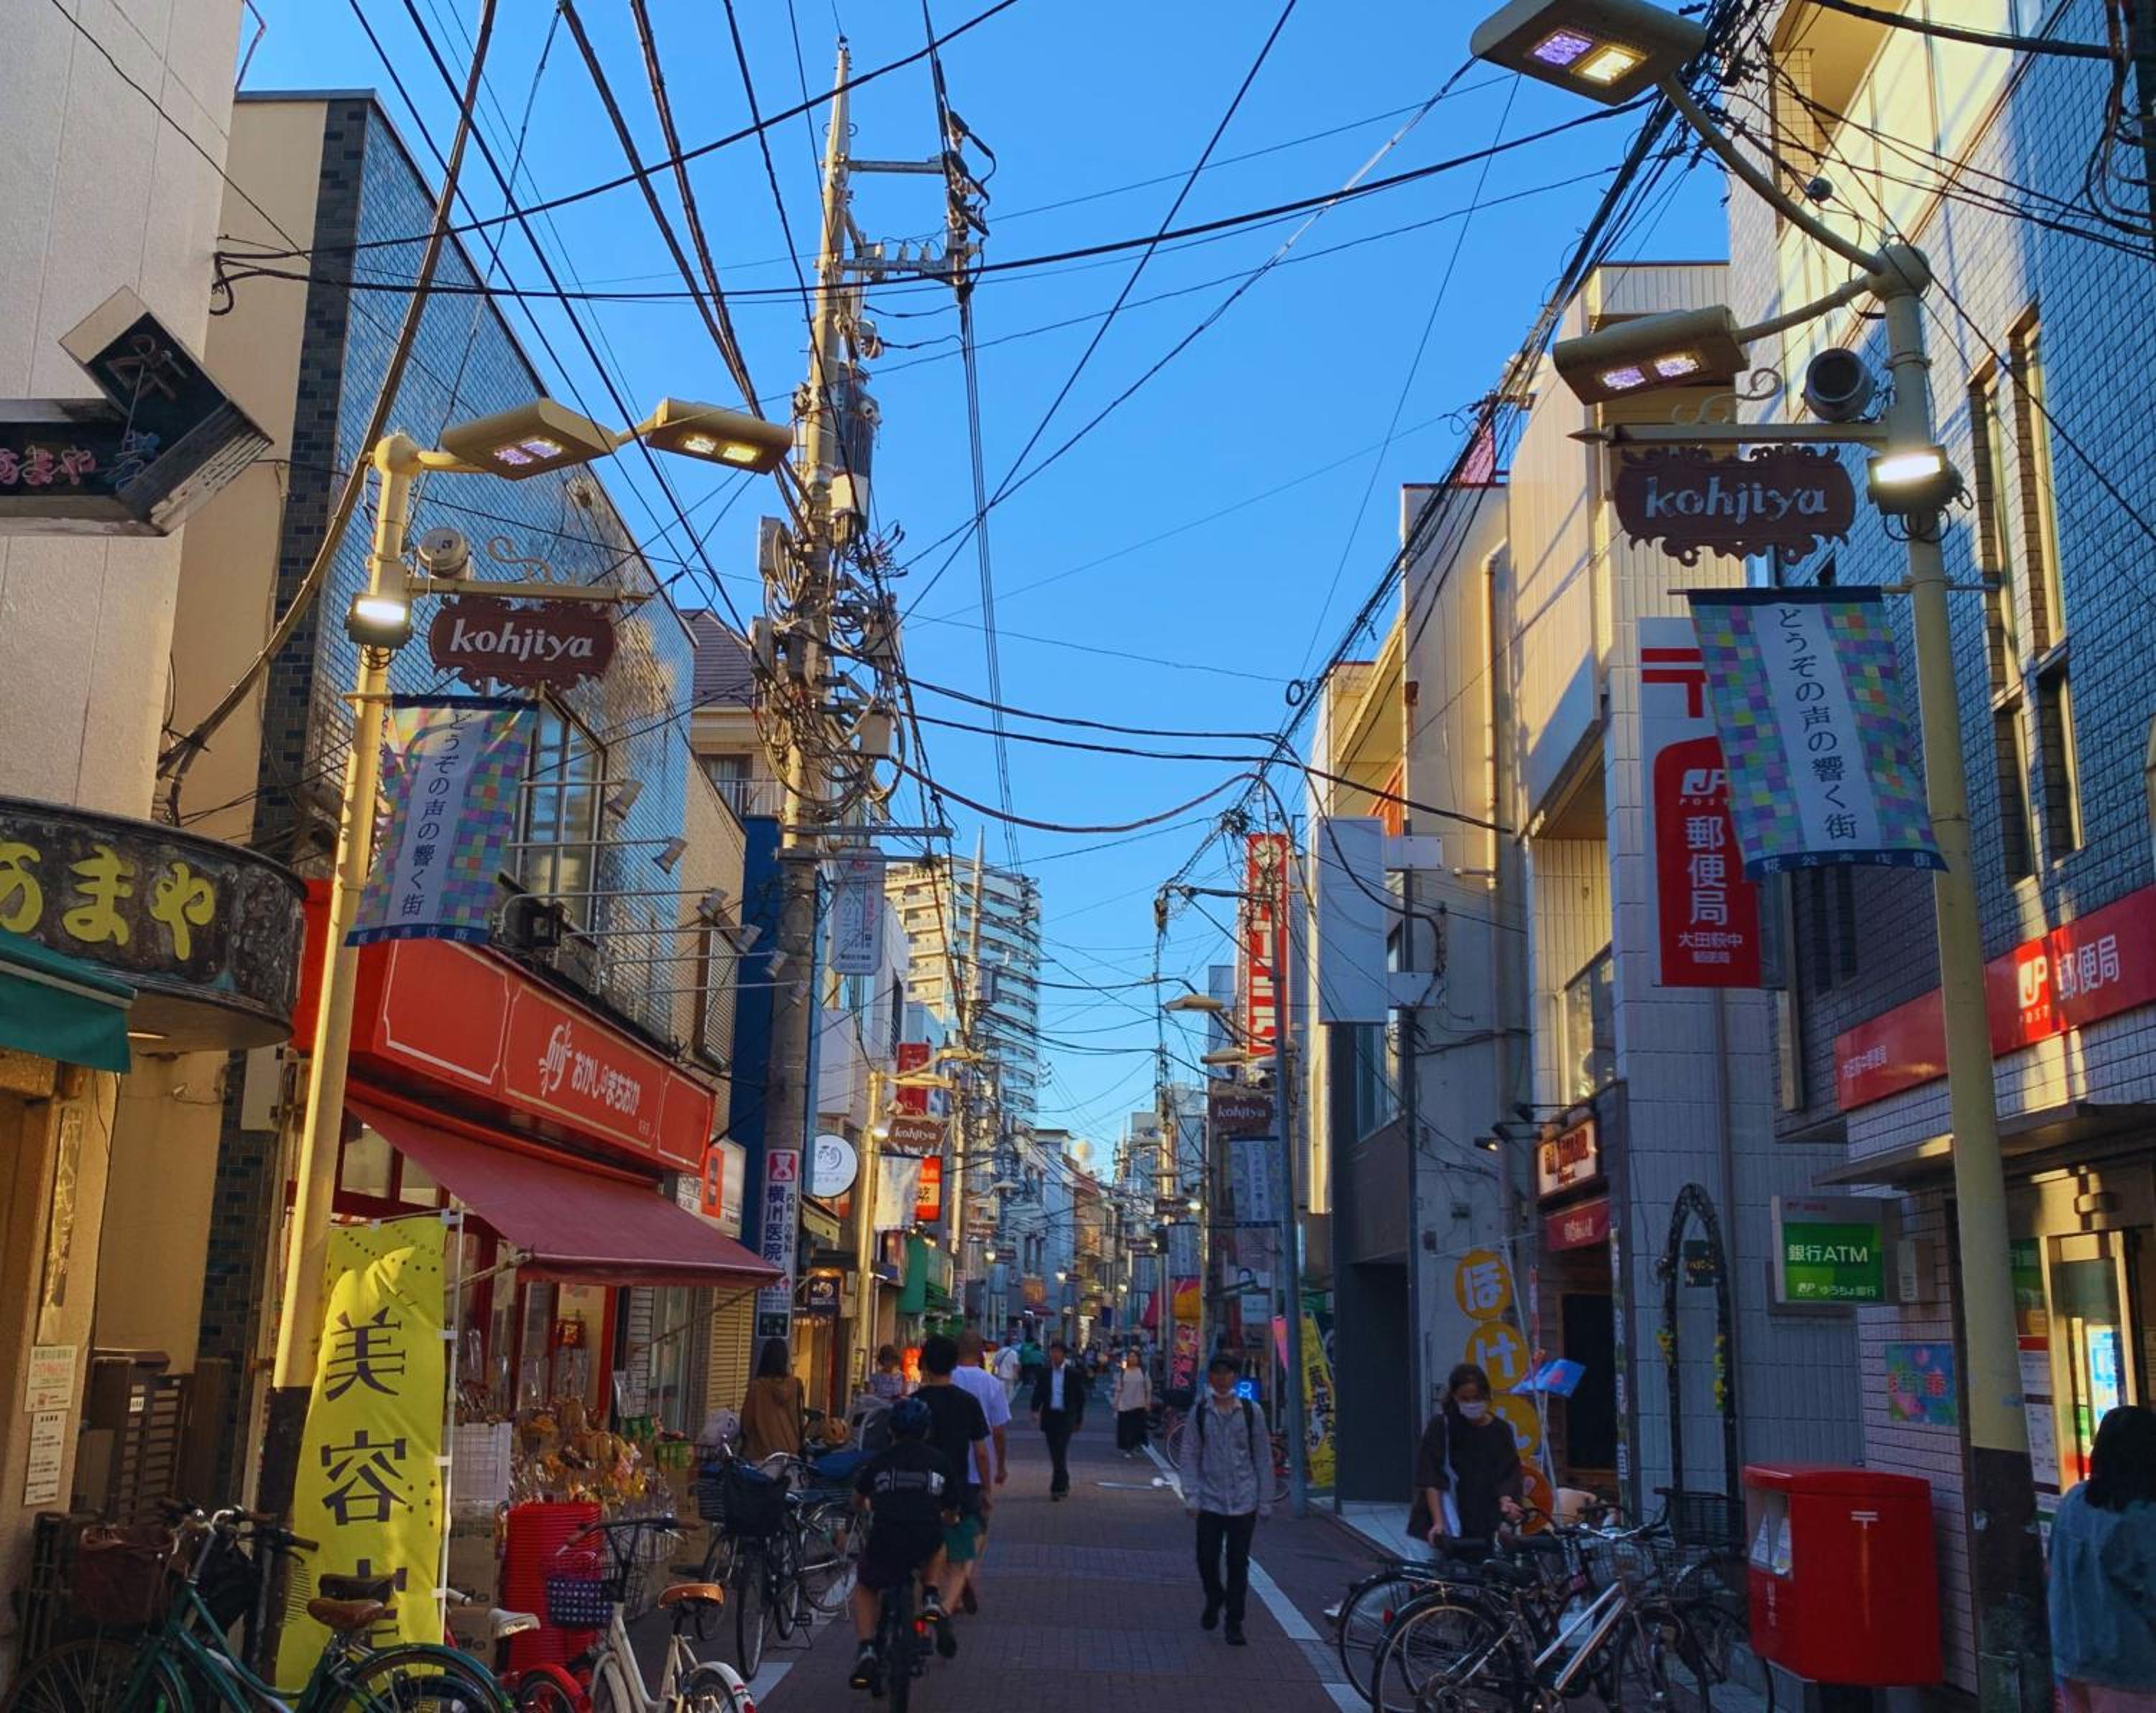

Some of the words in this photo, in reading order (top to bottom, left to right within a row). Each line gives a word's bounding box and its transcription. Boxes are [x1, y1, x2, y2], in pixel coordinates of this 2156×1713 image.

[1645, 476, 1829, 525] kohjiya
[450, 619, 594, 661] kohjiya
[1778, 608, 1858, 841] どうぞの声の響く街
[402, 713, 474, 917] どうぞの声の響く街
[1686, 815, 1728, 926] 郵便局
[2054, 934, 2120, 1001] 郵便局
[571, 1051, 641, 1116] おかしのまちおか
[763, 1184, 786, 1261] 横川医院
[1787, 1244, 1869, 1263] 銀行ATM
